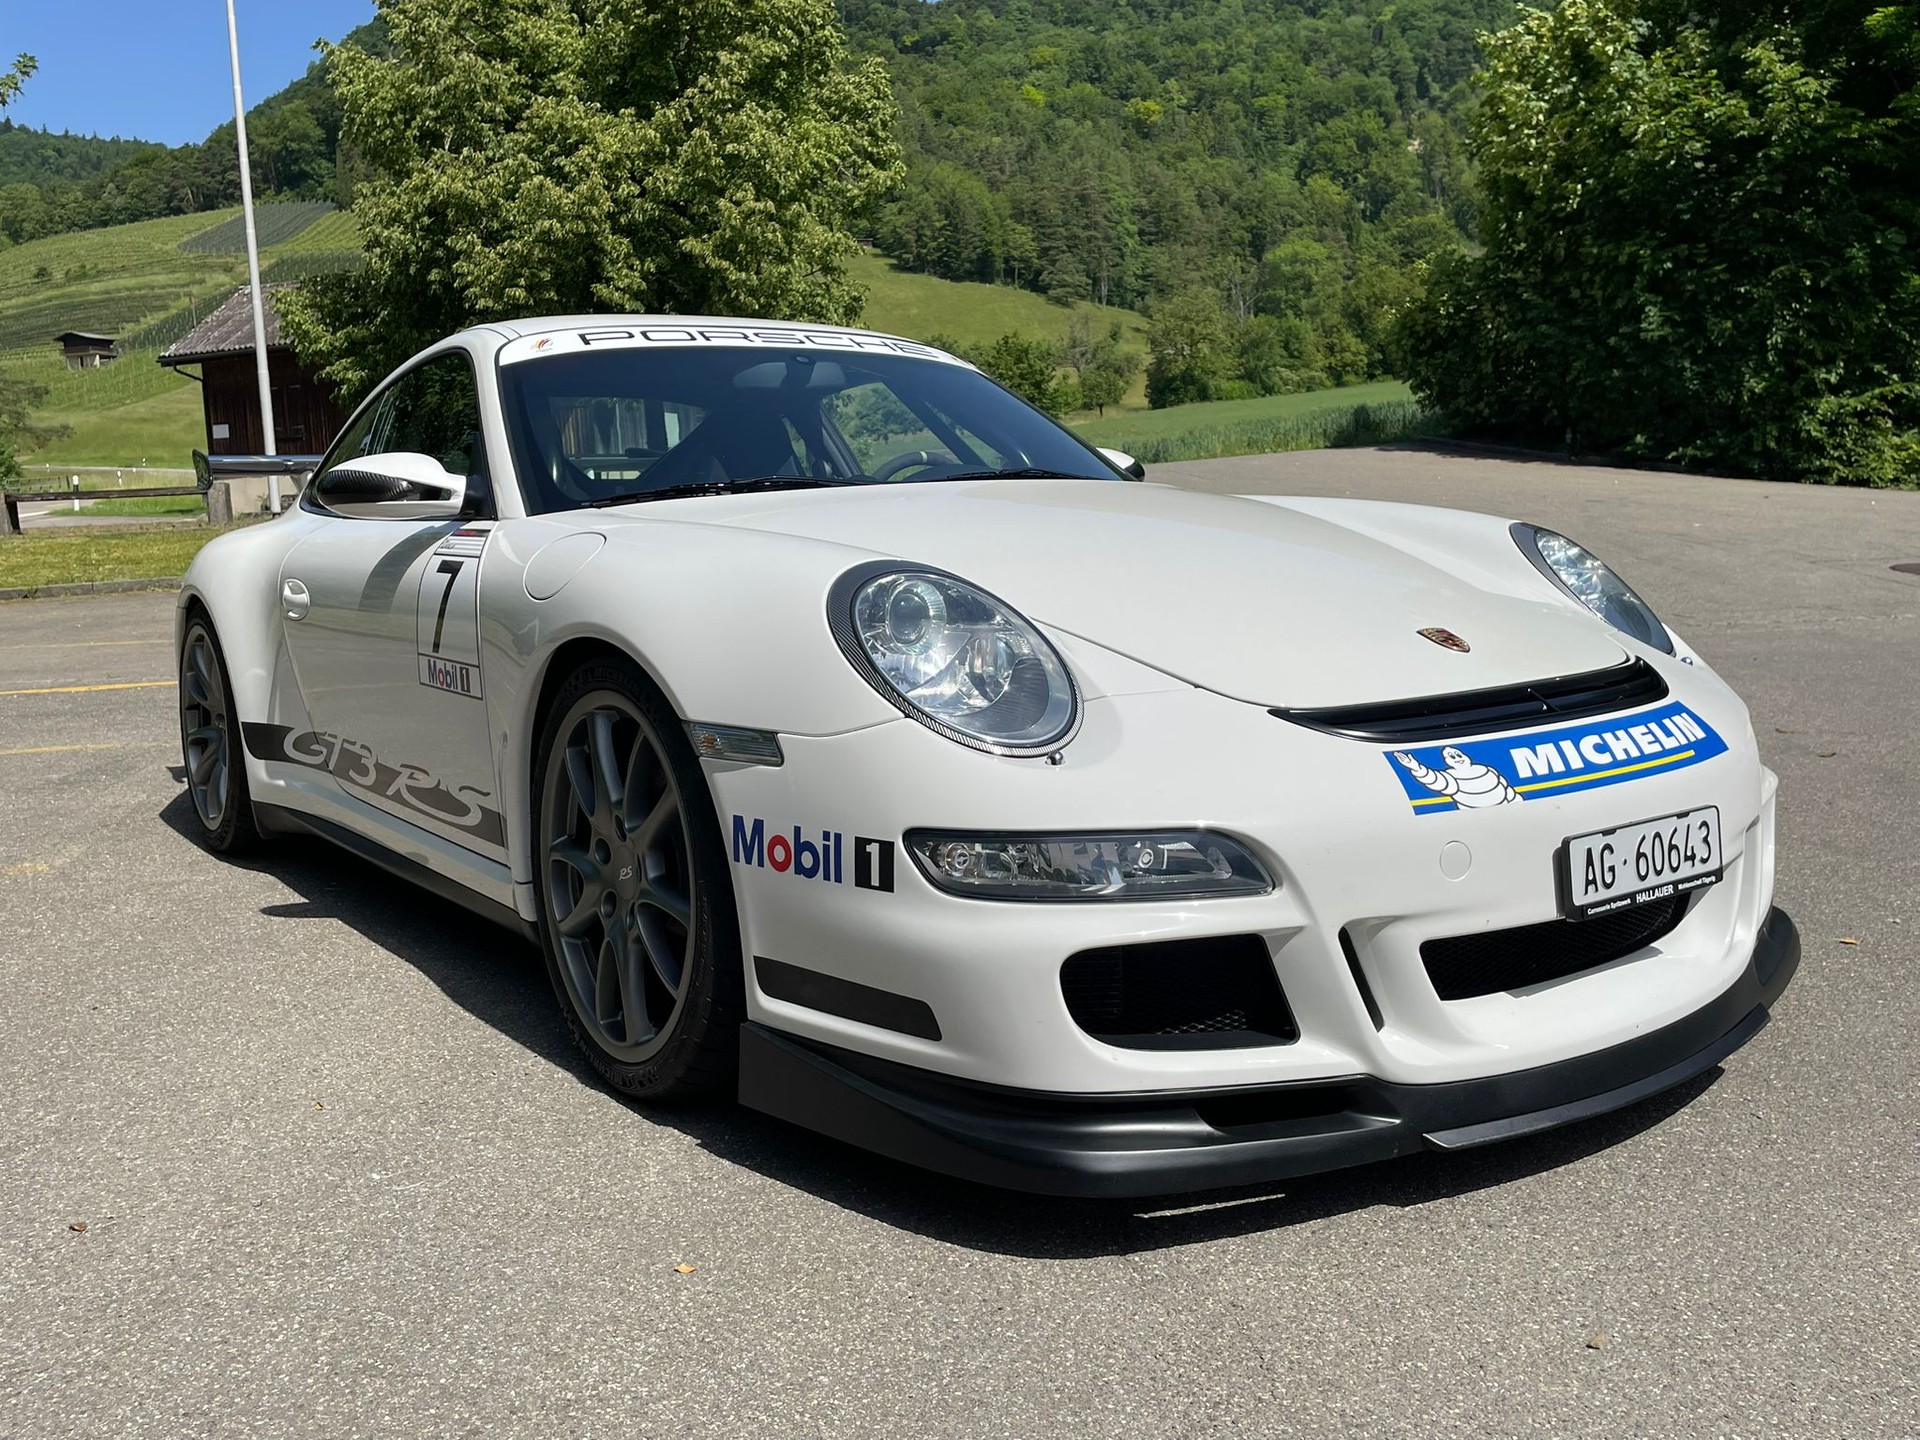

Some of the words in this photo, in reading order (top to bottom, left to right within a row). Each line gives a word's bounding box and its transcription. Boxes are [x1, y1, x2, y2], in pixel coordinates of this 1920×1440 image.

[577, 329, 940, 360] PORSCHE
[432, 560, 465, 654] 7
[427, 658, 459, 691] Mobil
[461, 667, 470, 692] 1
[283, 729, 379, 787] GT3
[386, 762, 490, 827] RS
[1509, 712, 1707, 779] MICHELIN
[732, 814, 843, 884] Mobil
[1635, 884, 1675, 904] HALLAUER
